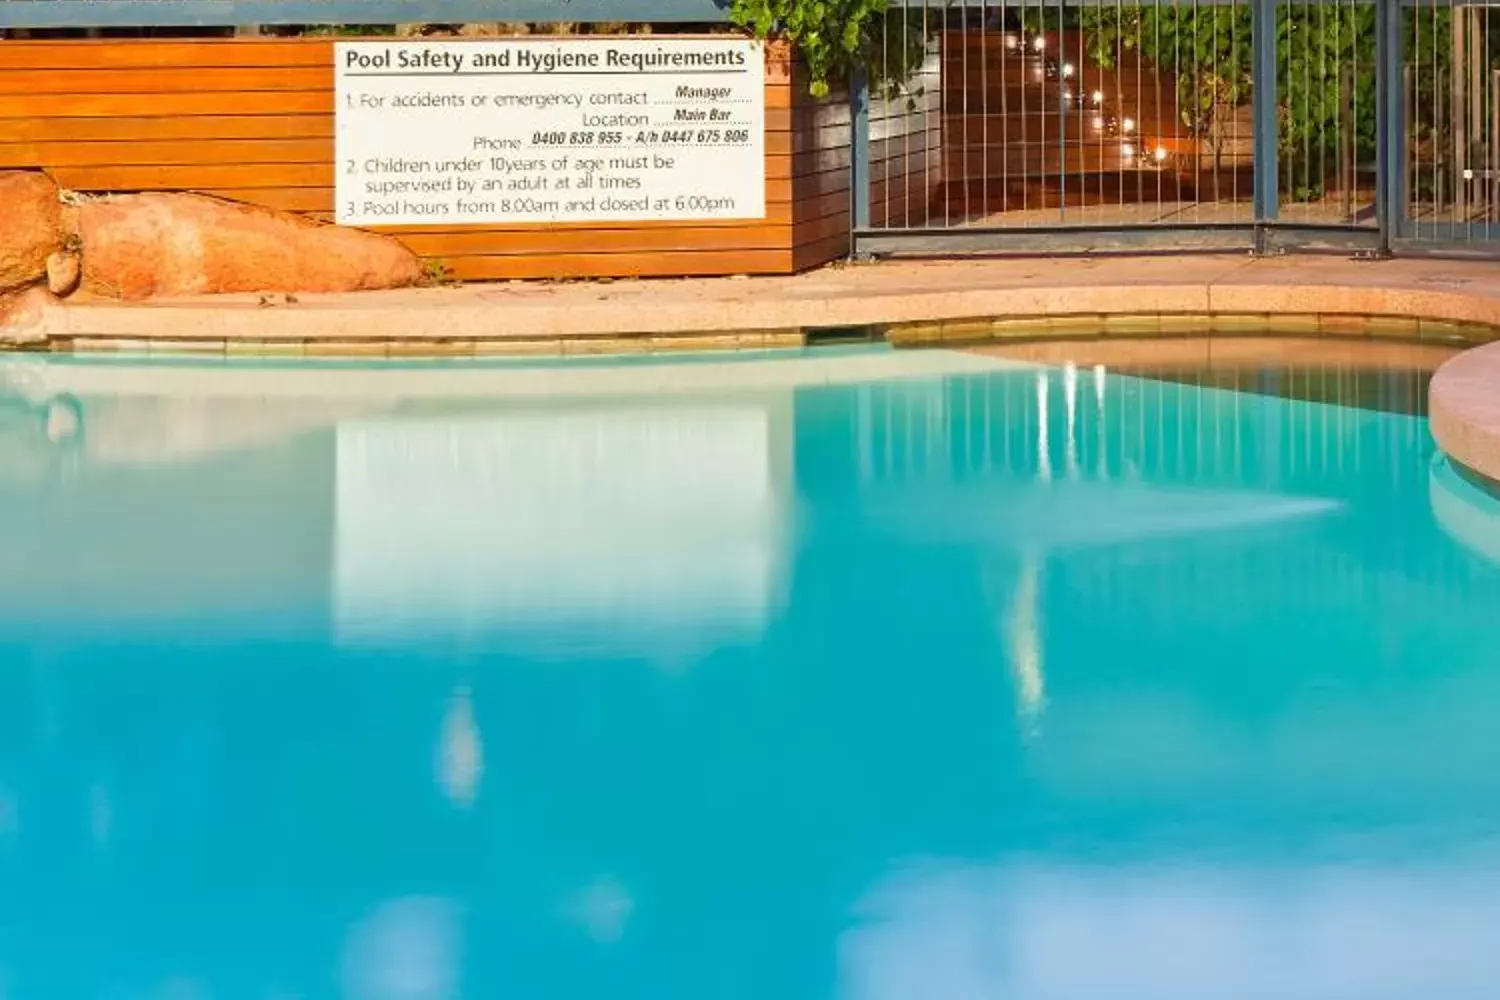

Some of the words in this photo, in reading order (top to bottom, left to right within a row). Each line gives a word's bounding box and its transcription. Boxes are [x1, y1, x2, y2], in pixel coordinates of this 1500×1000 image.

[346, 49, 390, 68] Pool
[398, 49, 464, 72] Safety
[473, 49, 510, 67] and
[517, 48, 599, 71] Hygiene
[607, 48, 745, 71] Requirements
[360, 93, 385, 109] For
[392, 91, 465, 107] accidents
[471, 94, 486, 107] or
[494, 92, 583, 109] emergency
[589, 91, 648, 105] contact
[675, 85, 732, 100] Manager
[582, 113, 649, 127] Location
[673, 108, 706, 121] Main
[709, 108, 731, 121] Bar
[473, 136, 521, 150] Phone
[532, 131, 566, 145] 0400
[365, 157, 430, 173] Children
[436, 157, 482, 172] under
[552, 154, 568, 170] of
[575, 158, 604, 174] age
[610, 155, 649, 169] must
[654, 154, 675, 169] be
[365, 177, 451, 195] supervised
[457, 176, 475, 193] by
[482, 178, 503, 190] an
[507, 174, 548, 190] adult
[554, 176, 570, 189] at
[576, 173, 593, 189] all
[600, 174, 641, 189] times
[363, 200, 399, 215] Pool
[404, 199, 449, 215] hours
[457, 199, 495, 213] from
[564, 197, 595, 212] and
[600, 195, 649, 212] closed
[653, 198, 671, 211] at
